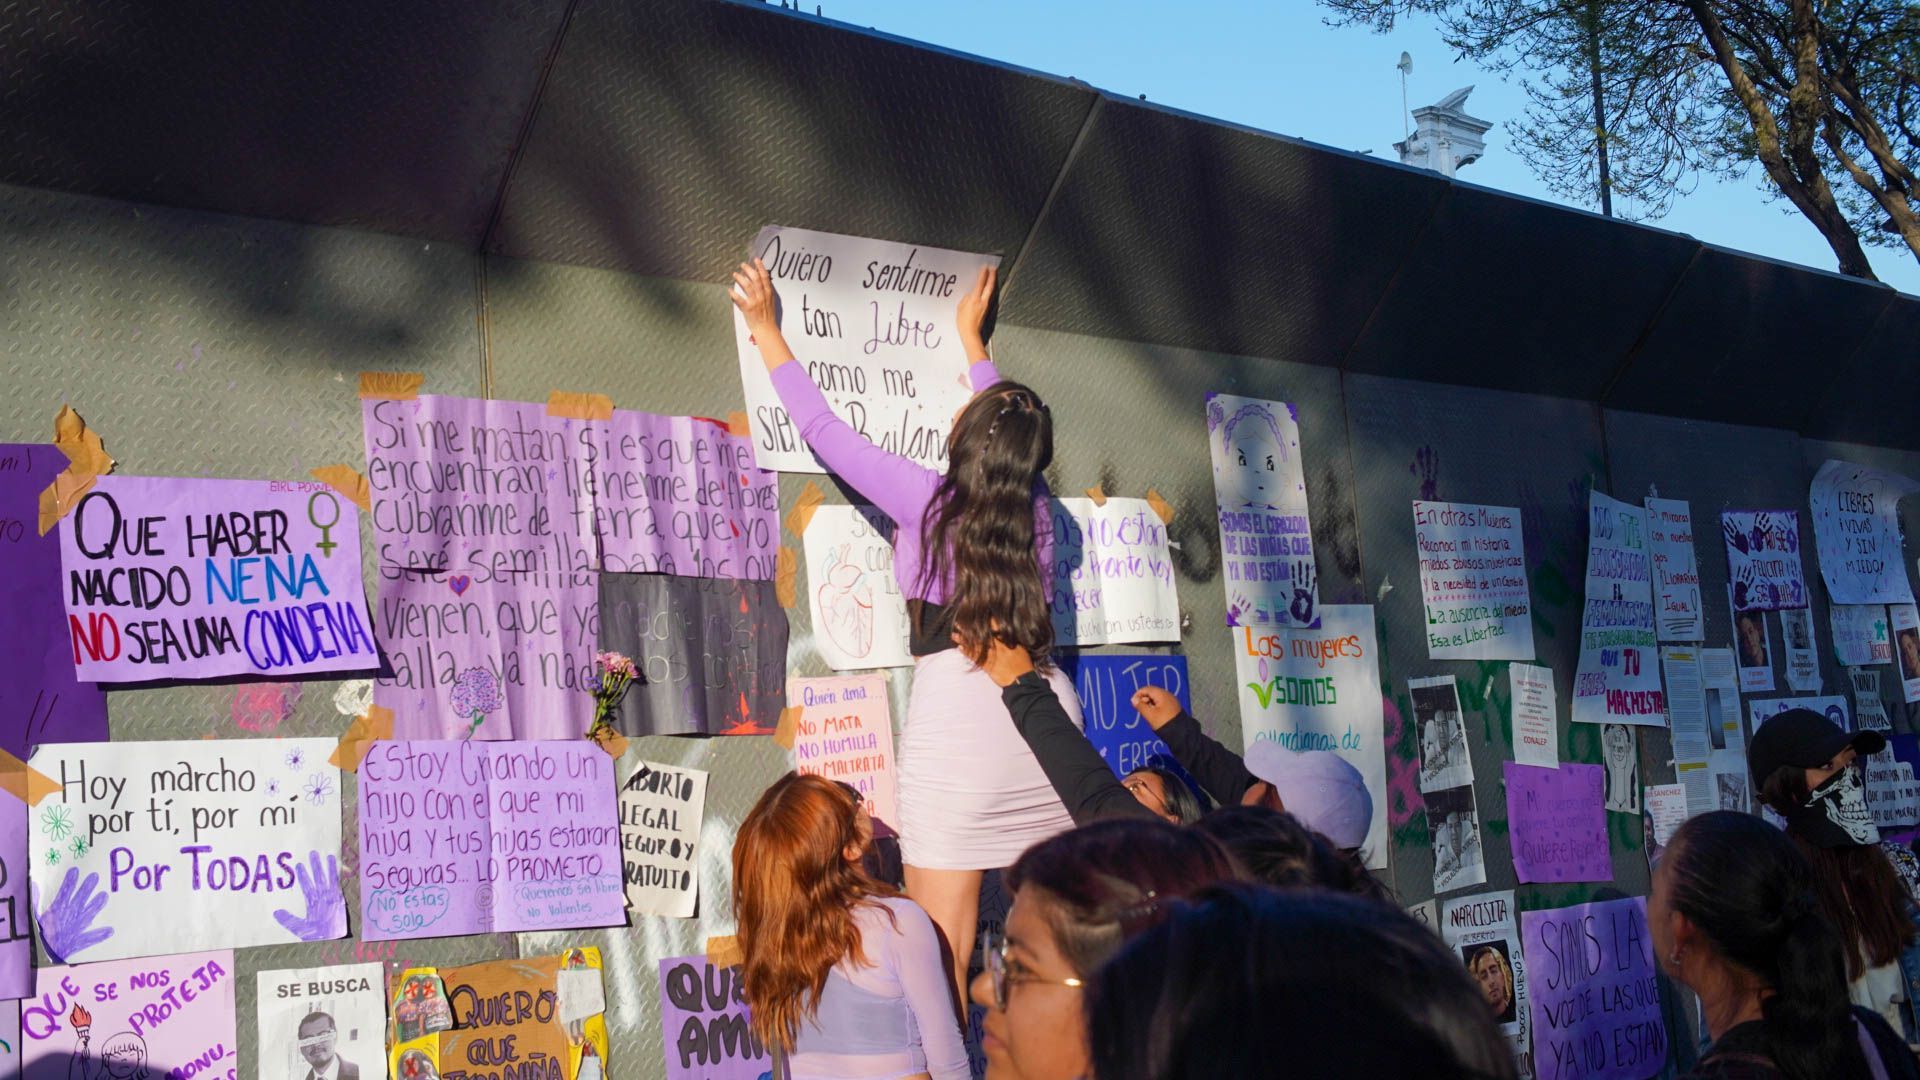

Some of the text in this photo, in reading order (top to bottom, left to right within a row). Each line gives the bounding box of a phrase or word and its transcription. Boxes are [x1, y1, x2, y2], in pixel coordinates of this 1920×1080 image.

[760, 235, 957, 297] Quiero sentirme
[802, 293, 941, 354] tan Libre
[809, 360, 916, 398] como me
[374, 400, 407, 449] Si
[416, 420, 464, 454] me
[657, 438, 711, 472] que
[716, 441, 751, 470] me
[695, 467, 725, 506] de
[727, 471, 781, 512] flores
[1838, 491, 1875, 515] LIBRES
[186, 509, 293, 557] HABER
[529, 493, 552, 537] de
[672, 510, 732, 552] que
[740, 517, 770, 549] yo
[1088, 516, 1113, 547] no
[1253, 513, 1265, 534] EL
[1413, 502, 1512, 529] En otras Mujeres
[1619, 512, 1642, 549] TE
[467, 533, 595, 589] semilla
[1225, 534, 1238, 555] DE
[1239, 536, 1257, 556] LAS
[1291, 536, 1311, 556] QUE
[1461, 539, 1472, 551] mi
[1474, 535, 1511, 551] historia
[1857, 537, 1876, 554] SIN
[71, 554, 331, 610] NACIDO NENA
[1228, 560, 1240, 581] YA
[1243, 561, 1258, 581] NO
[1431, 577, 1440, 592] la
[1480, 576, 1489, 589] de
[497, 599, 558, 646] que
[1427, 605, 1448, 625] La
[1449, 605, 1491, 624] ausencia
[69, 602, 375, 670] NO SEA UNA CONDENA
[1245, 626, 1363, 668] Las mujeres
[1429, 622, 1505, 648] Esa es Libertad
[487, 650, 525, 700] ya
[1601, 649, 1618, 667] QUE
[1624, 648, 1640, 676] TU
[1606, 689, 1664, 715] MACHISTA
[798, 715, 862, 736] NO MATA
[1342, 724, 1363, 751] de
[799, 732, 877, 760] NO HUMILLA
[61, 757, 256, 810] Hoy marcho
[89, 810, 135, 847] por
[191, 806, 240, 843] por
[260, 795, 299, 826] mí
[365, 782, 585, 825] hijo con el que mi
[620, 801, 683, 832] LEGAL
[364, 823, 412, 858] hija
[445, 825, 483, 855] tus
[488, 821, 542, 858] hijas
[621, 833, 682, 859] EGURO
[109, 845, 298, 893] Por TODAS
[507, 853, 603, 883] PROMETO
[626, 861, 691, 892] RATUITO
[1451, 899, 1508, 928] NARCISITA
[1463, 930, 1496, 944] ALBERTO
[1541, 909, 1648, 990] SOMOS LA
[22, 970, 171, 1040] QUE SE NOS
[128, 960, 226, 1037] PROTEJA
[277, 977, 371, 998] SE BUSCA
[1543, 976, 1661, 1029] VOZ DE LAS QUE
[450, 984, 558, 1030] QUIERO
[1517, 1005, 1526, 1045] POCOS
[467, 1034, 520, 1066] QUE
[1550, 1019, 1665, 1080] YA NO ESTAN
